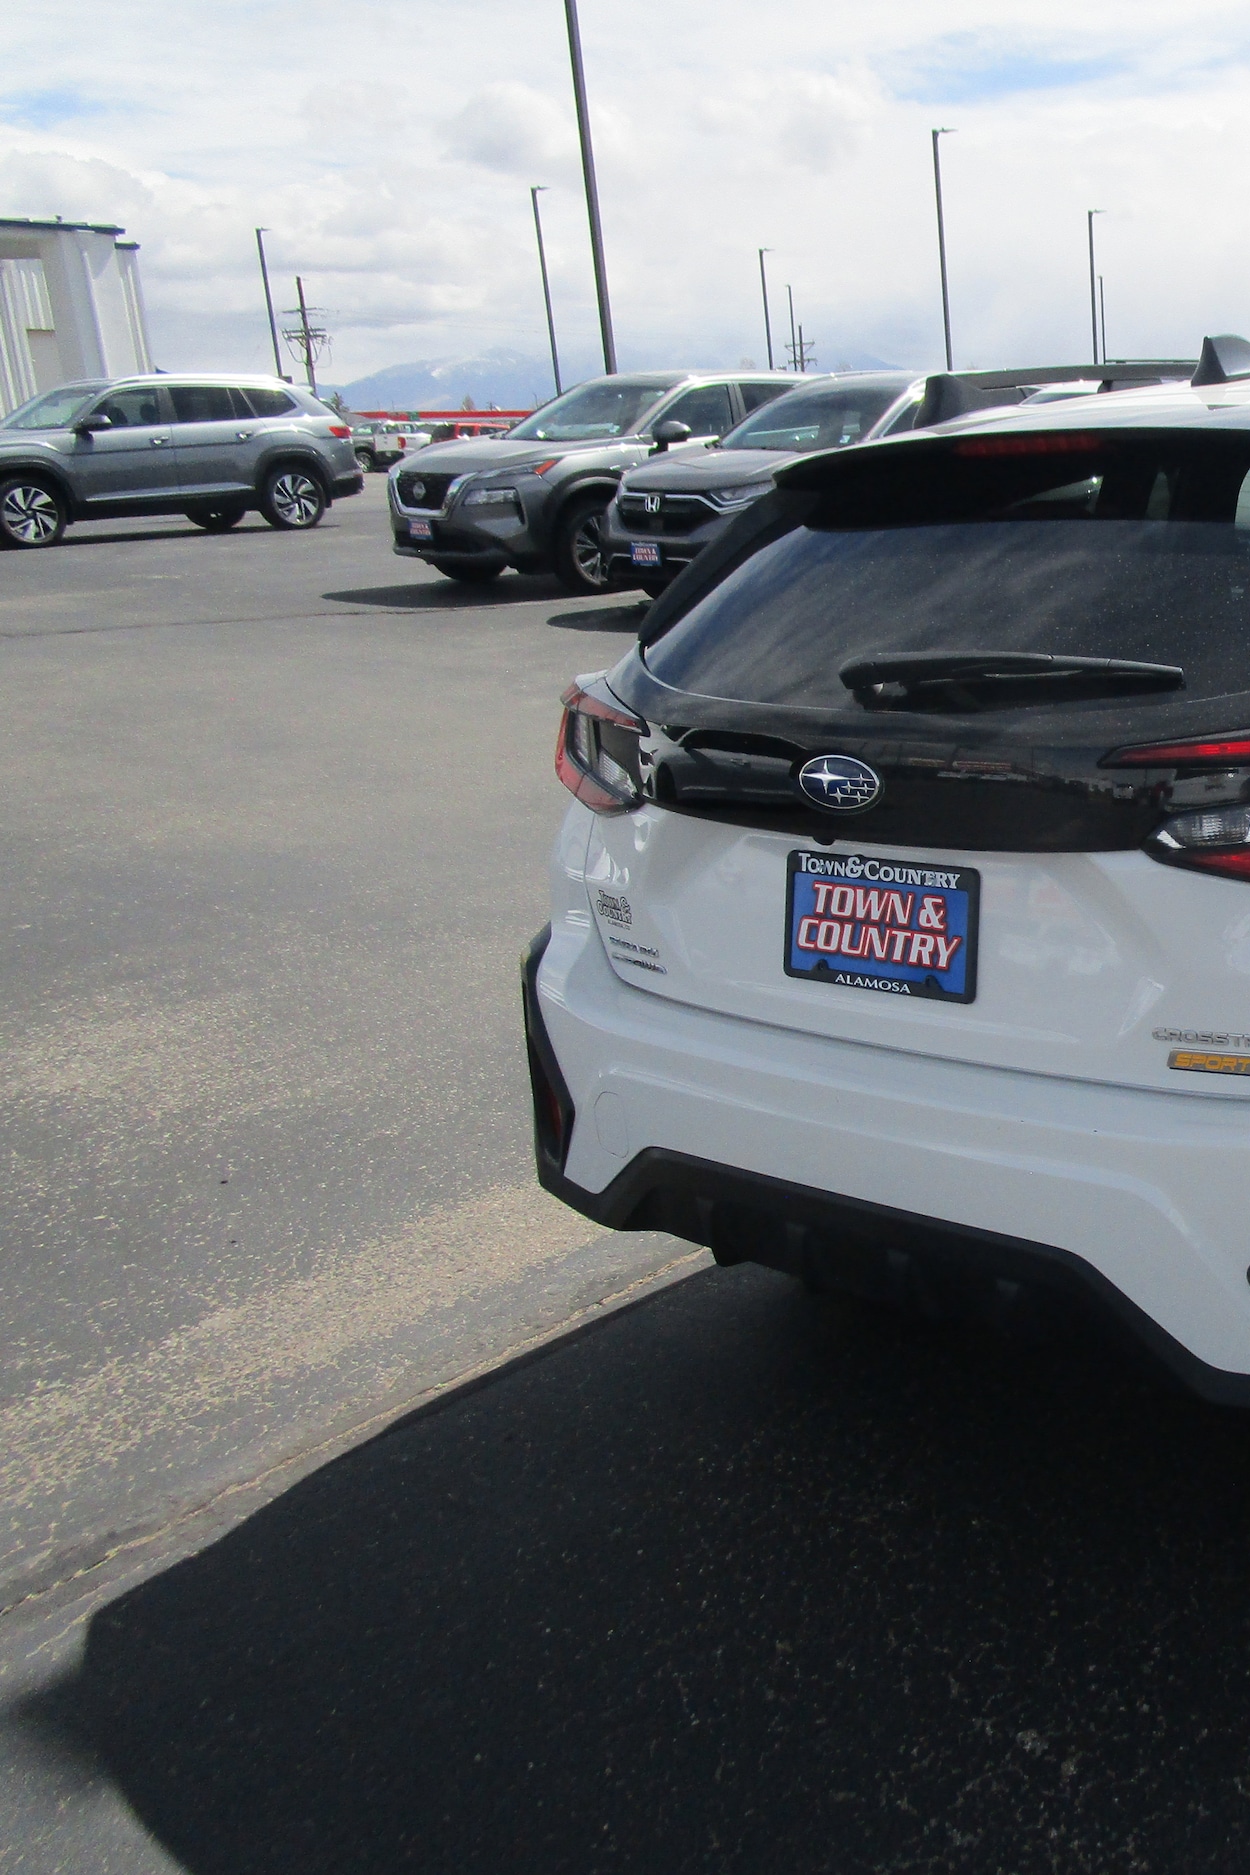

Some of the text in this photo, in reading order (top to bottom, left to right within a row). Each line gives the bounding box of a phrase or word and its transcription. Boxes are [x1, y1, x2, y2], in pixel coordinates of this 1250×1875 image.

[813, 881, 947, 931] TOWN &
[797, 916, 962, 971] COUNTRY
[835, 973, 911, 995] ALAMOSA
